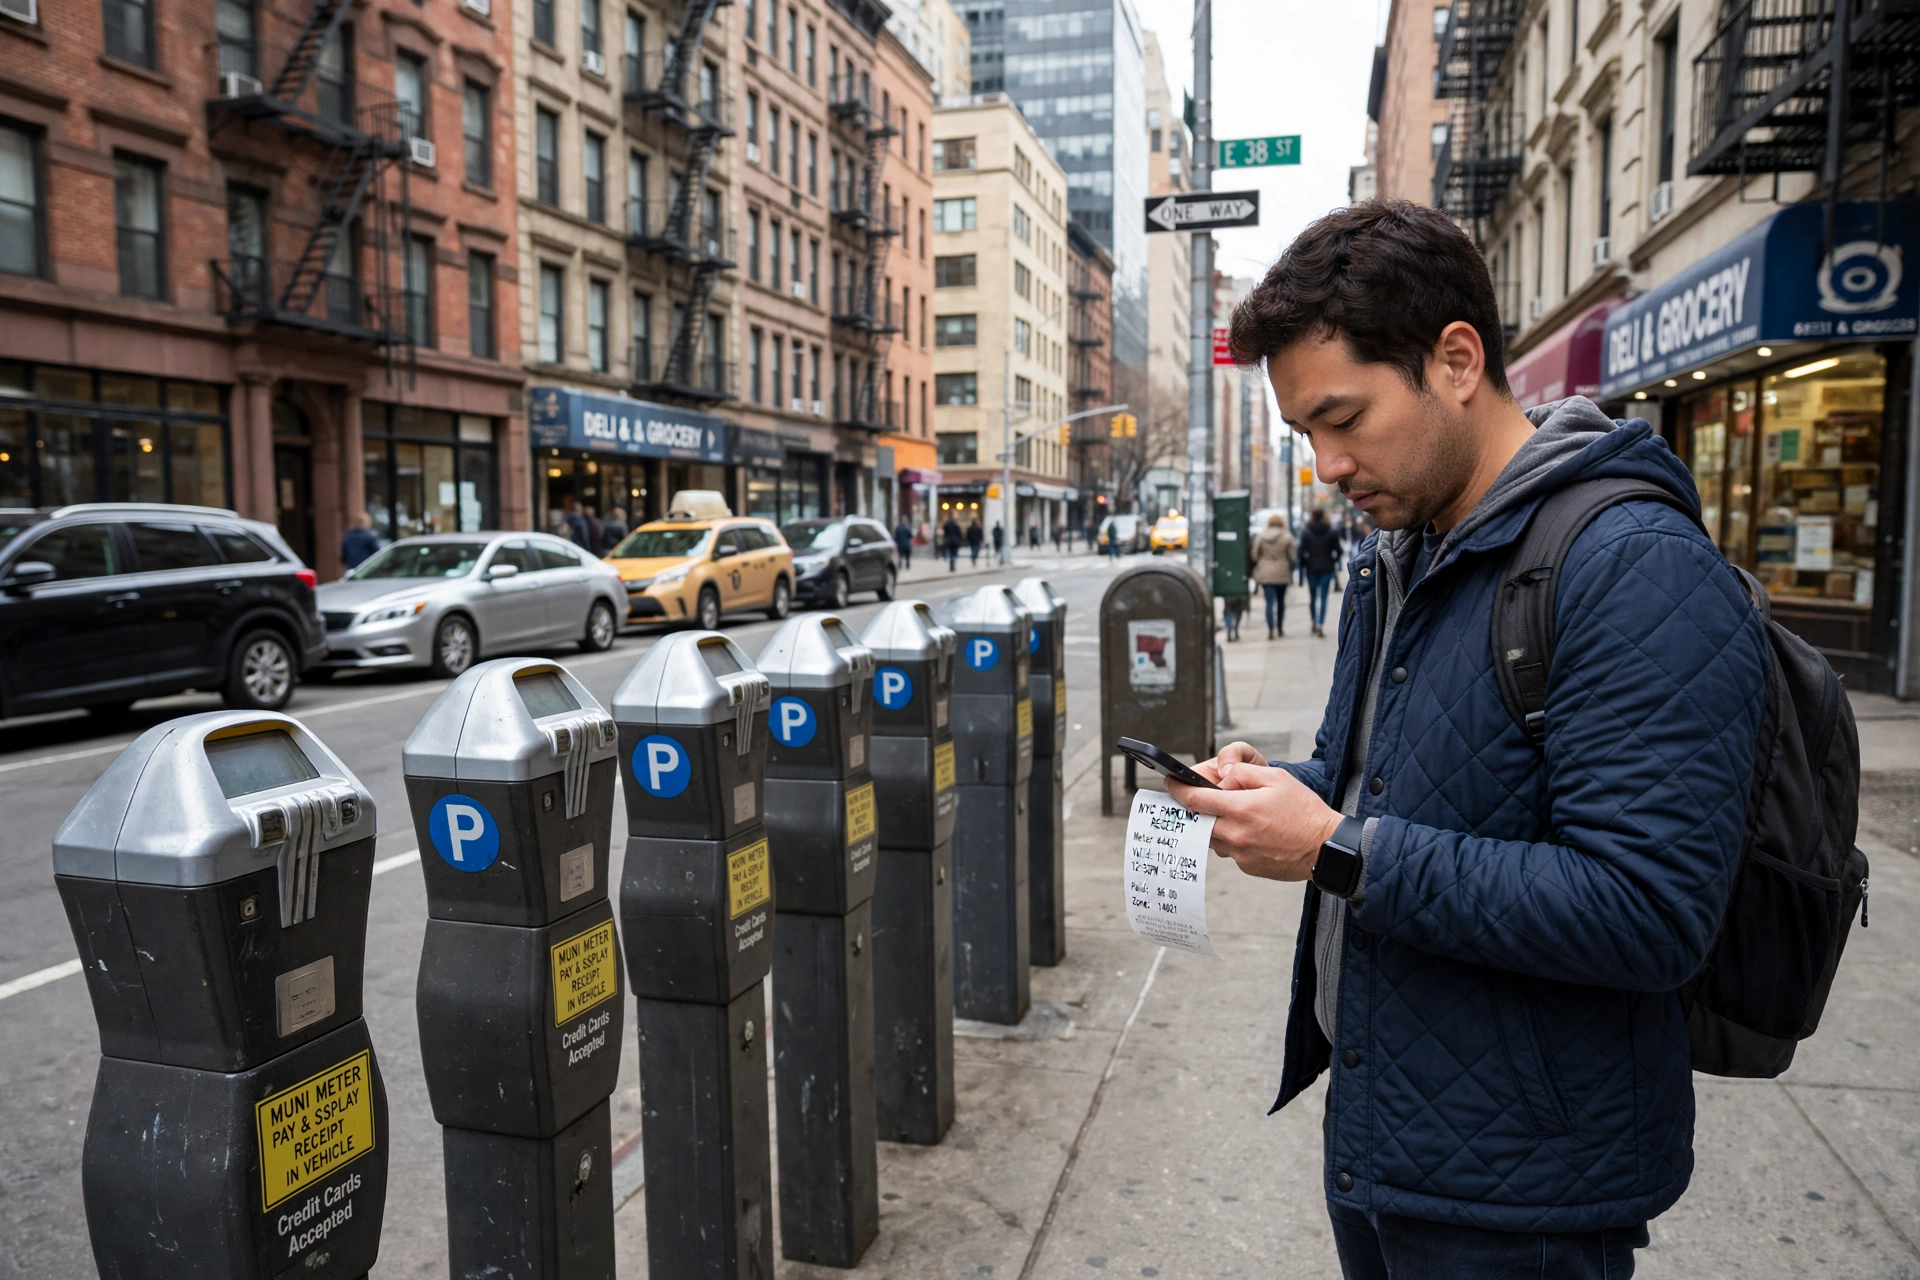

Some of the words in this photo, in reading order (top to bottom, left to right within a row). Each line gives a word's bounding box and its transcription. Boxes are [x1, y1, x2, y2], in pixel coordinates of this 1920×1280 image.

[1225, 142, 1236, 165] E
[1244, 139, 1269, 165] 38
[1276, 139, 1293, 157] ST
[1161, 204, 1194, 221] ONE
[1208, 202, 1244, 218] WAY
[1608, 318, 1640, 377] DELI
[1641, 311, 1654, 363] &
[1657, 257, 1750, 355] GROCERY
[583, 411, 617, 439] DELI
[618, 416, 630, 442] &
[646, 420, 702, 449] GROCERY
[882, 672, 905, 704] P
[780, 702, 807, 741] P
[647, 743, 679, 790] P
[1138, 803, 1156, 814] NYC
[445, 804, 484, 862] P
[1132, 896, 1150, 909] Zone:
[559, 943, 580, 966] MUNI
[584, 929, 609, 953] METER
[560, 964, 573, 982] PAY
[576, 961, 581, 974] &
[572, 967, 599, 993] RECEIPT
[567, 998, 575, 1012] IN
[577, 981, 606, 1006] VEHICLE
[563, 1023, 586, 1049] Credit
[588, 1010, 610, 1034] Cards
[568, 1030, 605, 1067] Accepted
[270, 1090, 310, 1126] MUNI
[316, 1066, 361, 1103] METER
[272, 1122, 296, 1149] PAY
[301, 1115, 311, 1133] &
[315, 1088, 360, 1125] SSPLAY
[294, 1119, 344, 1160] RECEIPT
[286, 1166, 299, 1186] IN
[303, 1135, 354, 1175] VEHICLE
[277, 1196, 320, 1237] Credit
[324, 1172, 361, 1207] Cards
[288, 1199, 353, 1257] Accepted
